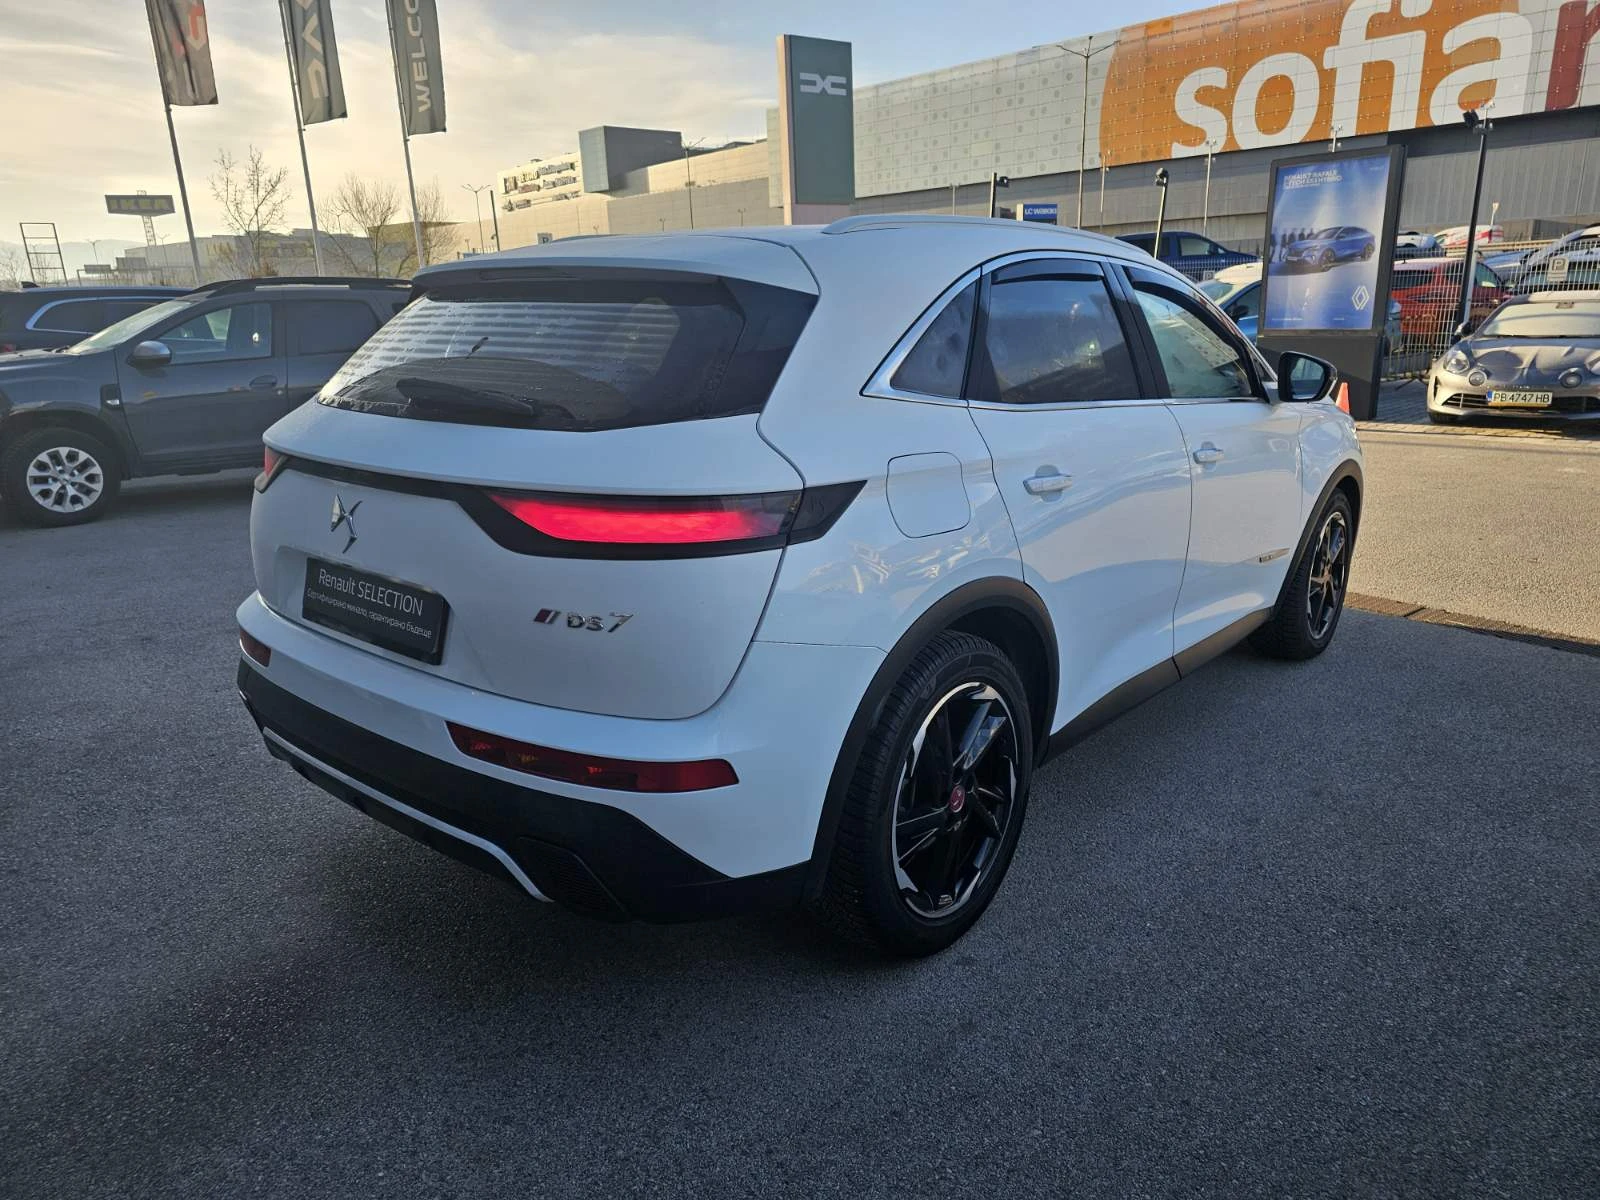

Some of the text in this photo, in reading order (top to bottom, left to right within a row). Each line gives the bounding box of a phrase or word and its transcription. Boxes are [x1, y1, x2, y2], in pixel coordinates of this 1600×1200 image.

[1509, 393, 1534, 403] 4747
[319, 568, 423, 616] Renault SELECTION
